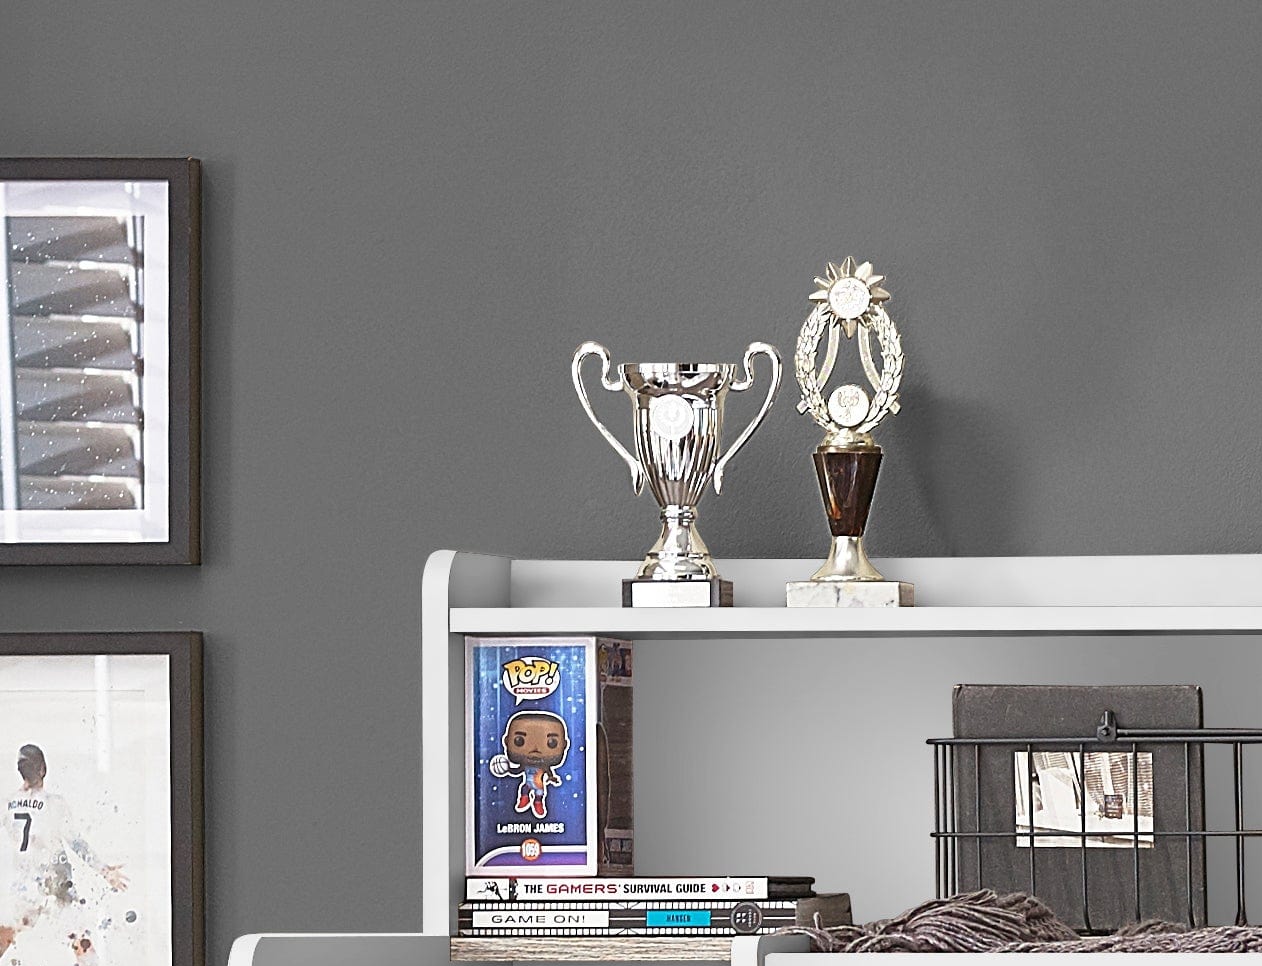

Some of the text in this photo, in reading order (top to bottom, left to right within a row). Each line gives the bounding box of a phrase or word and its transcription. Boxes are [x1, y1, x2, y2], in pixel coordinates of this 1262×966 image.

[502, 660, 559, 688] POP!
[14, 813, 32, 851] 7
[497, 822, 565, 834] LeBRON JAMES
[524, 884, 706, 894] THE GAMERS' SURVIVAL GUIDE
[491, 914, 586, 924] GAME ON!
